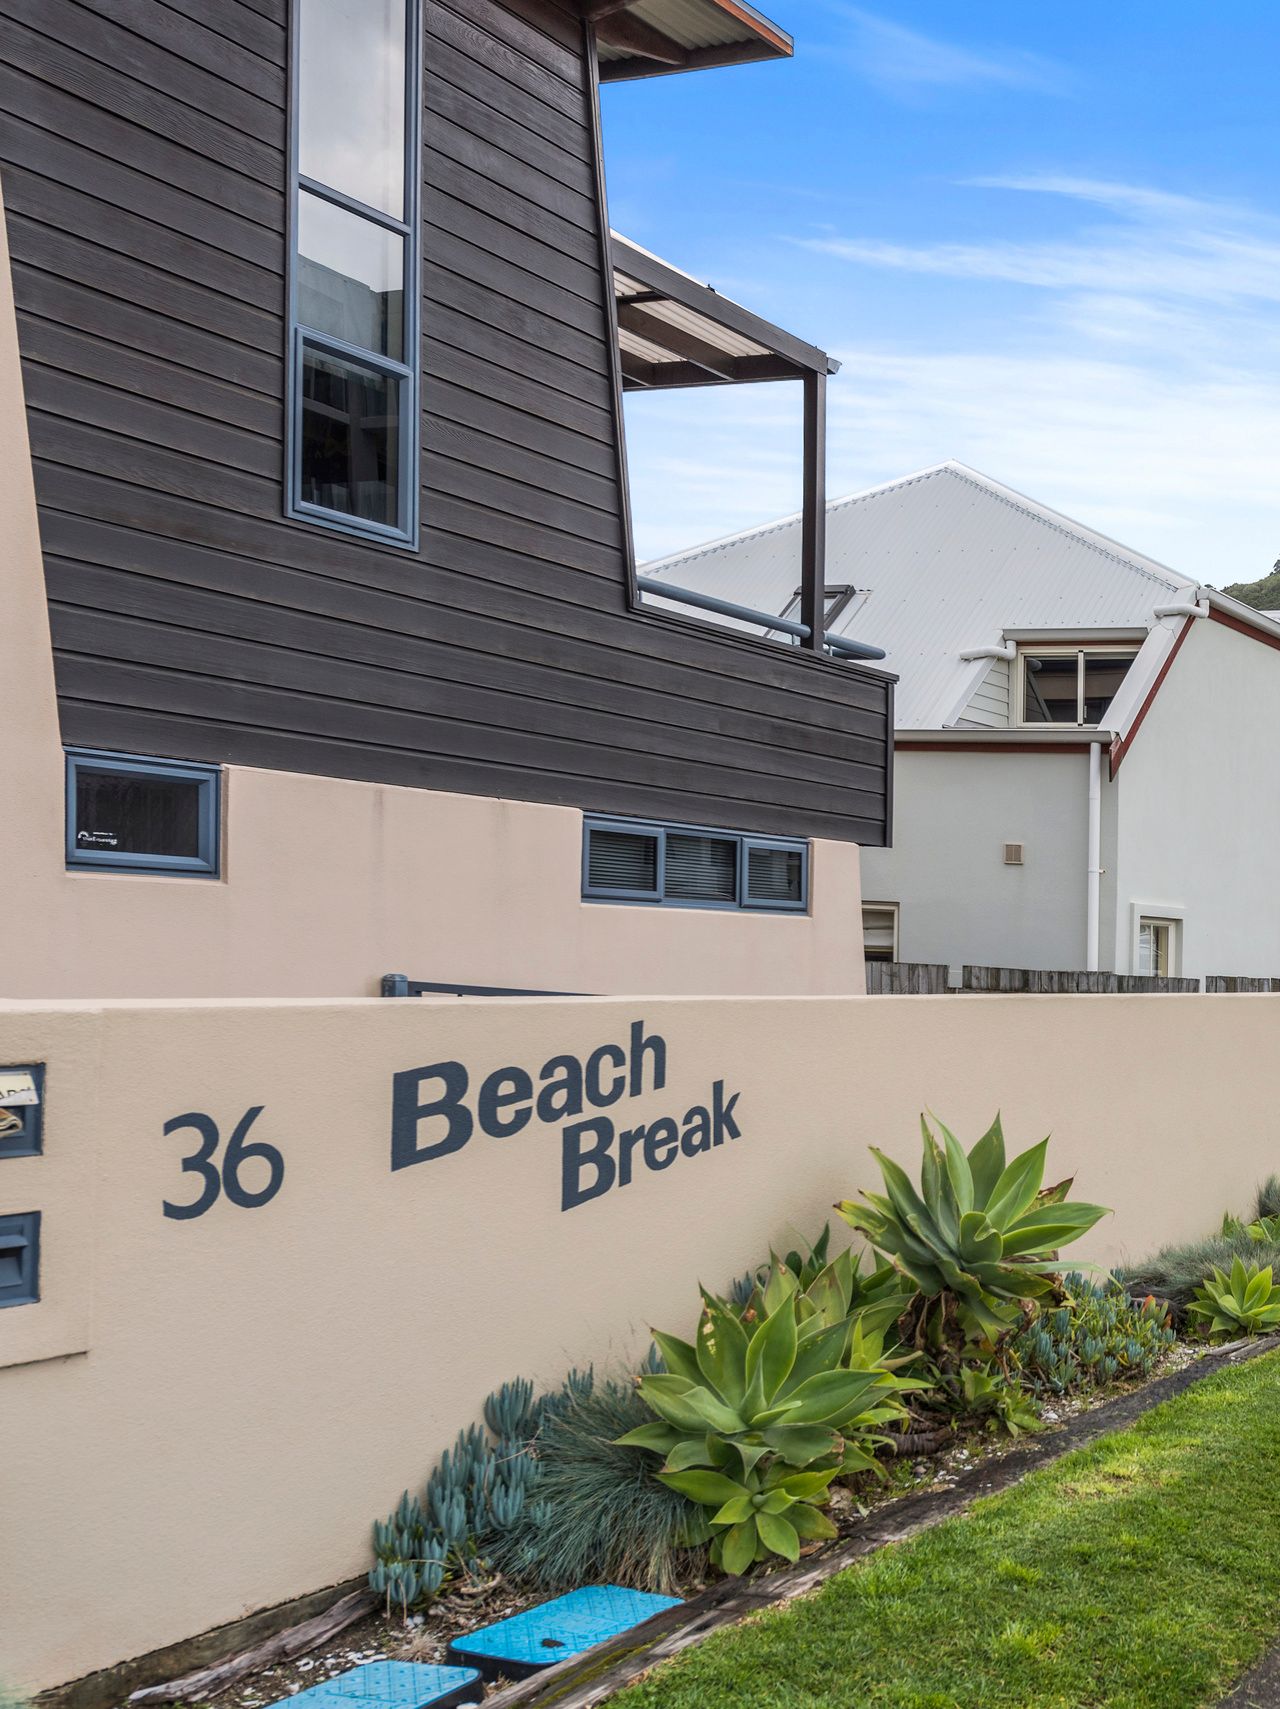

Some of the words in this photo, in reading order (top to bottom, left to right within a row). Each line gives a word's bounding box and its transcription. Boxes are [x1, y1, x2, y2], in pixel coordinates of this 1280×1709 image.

[391, 1020, 667, 1172] Beach
[561, 1080, 742, 1212] Break
[162, 1106, 285, 1220] 36
